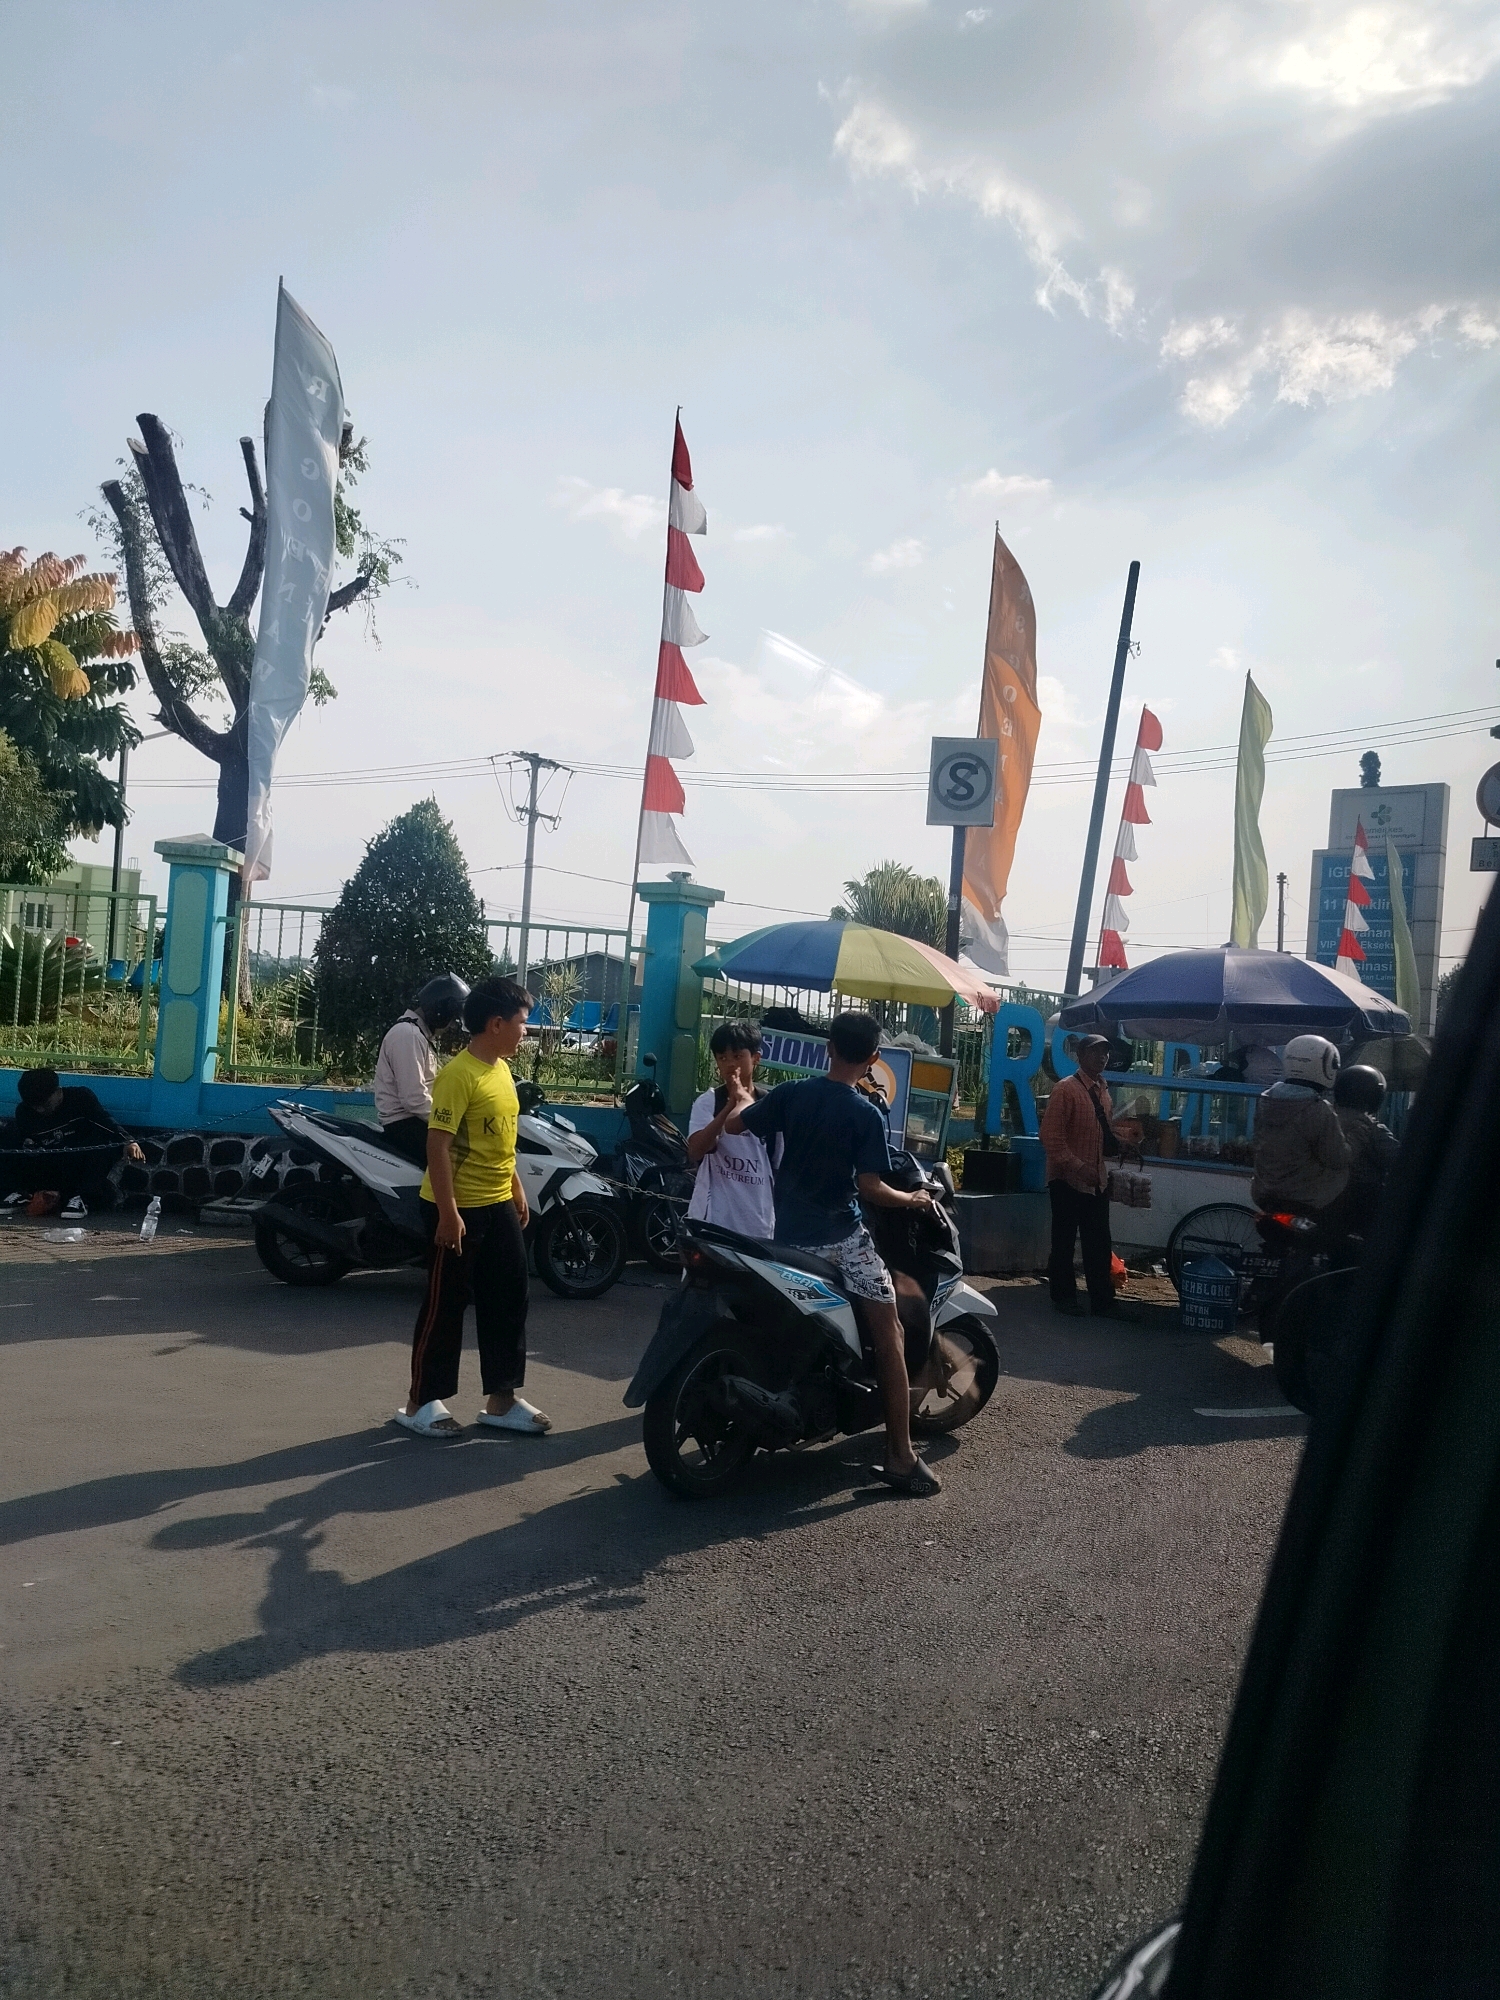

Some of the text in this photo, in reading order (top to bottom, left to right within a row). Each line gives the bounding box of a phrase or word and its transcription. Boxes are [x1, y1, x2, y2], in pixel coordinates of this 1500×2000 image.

[1323, 898, 1337, 911] 11
[1320, 940, 1337, 949] VIP
[760, 1033, 831, 1072] SIOM
[723, 1155, 759, 1174] SDN
